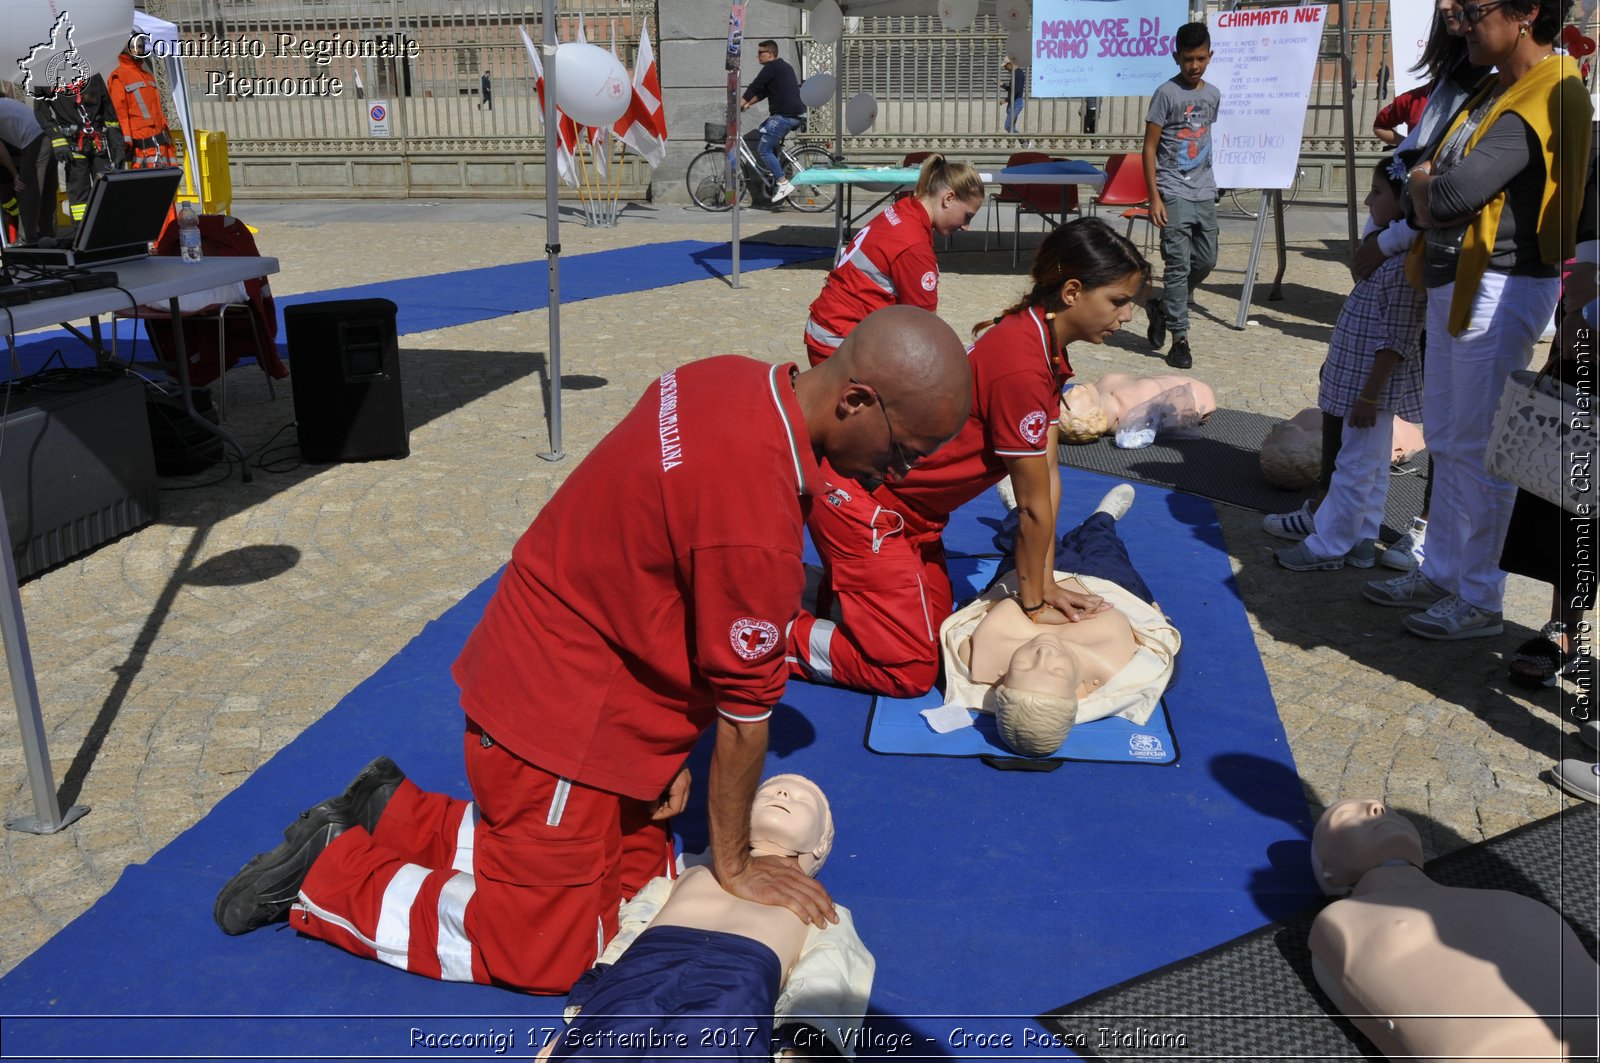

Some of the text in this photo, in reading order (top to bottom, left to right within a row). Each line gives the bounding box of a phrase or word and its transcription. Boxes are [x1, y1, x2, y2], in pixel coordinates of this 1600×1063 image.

[1041, 16, 1160, 39] MANOVRE DI
[1218, 8, 1322, 27] CHIAMATA NUE
[1036, 38, 1089, 59] PRIMO
[660, 413, 683, 473] ITALIANA
[1129, 749, 1166, 757] Laerdal
